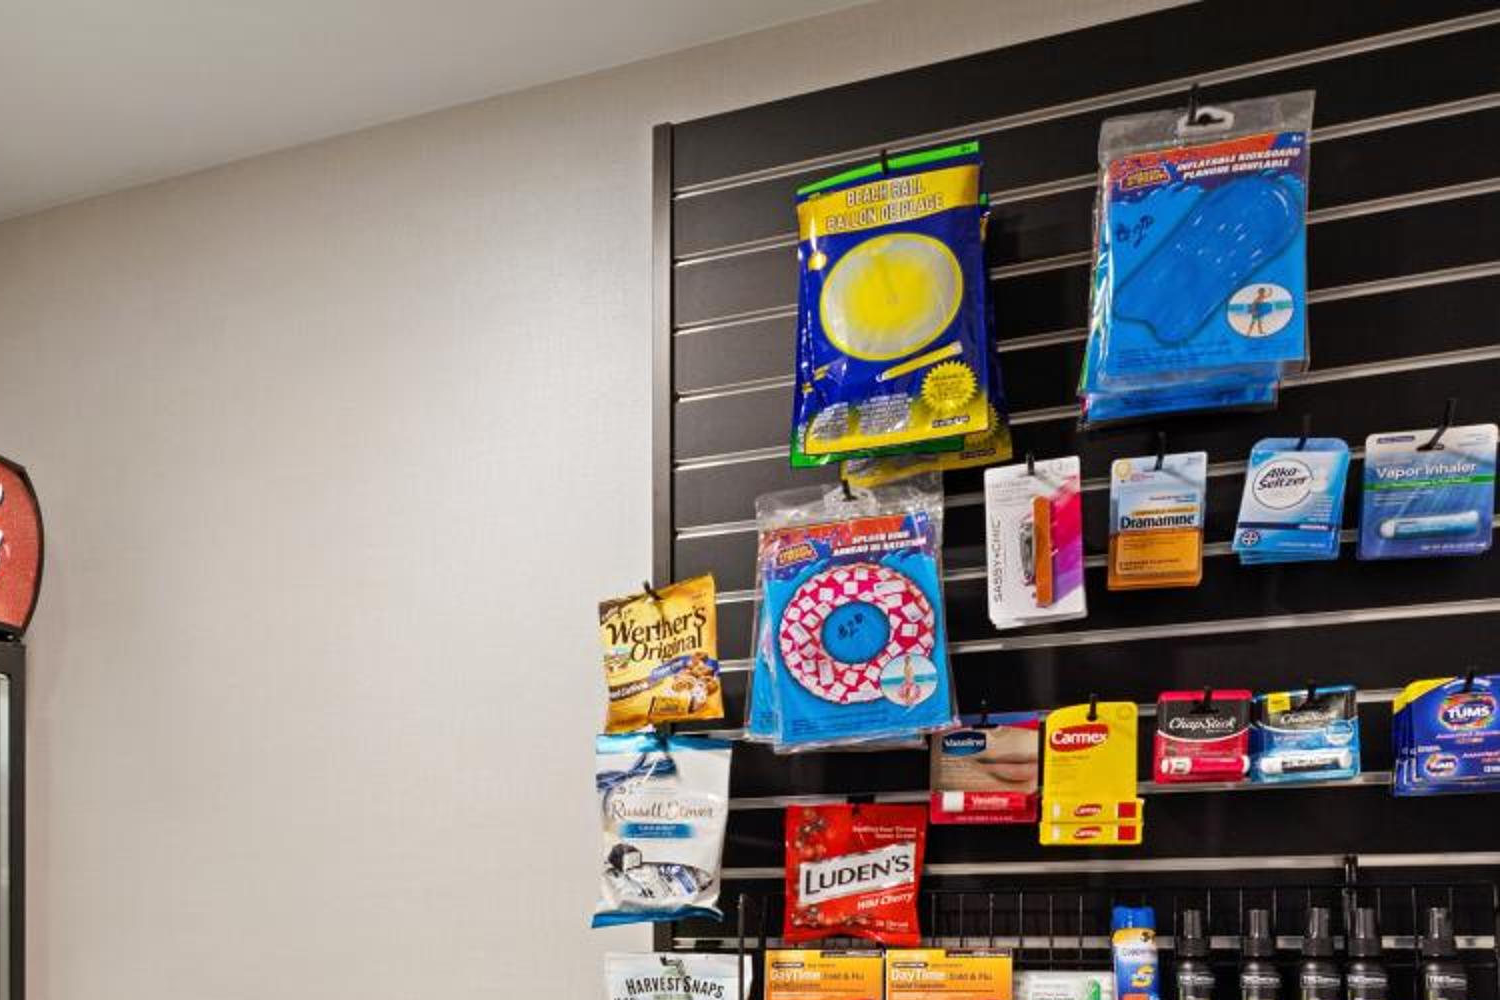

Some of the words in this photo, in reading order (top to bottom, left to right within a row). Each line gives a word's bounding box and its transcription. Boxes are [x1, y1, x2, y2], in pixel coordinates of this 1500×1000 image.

[847, 181, 889, 207] BEACH
[891, 177, 924, 199] BALL
[826, 208, 877, 231] BALLON
[1376, 466, 1423, 480] Vapor
[1425, 462, 1477, 475] Inhaler
[1121, 514, 1195, 529] Dramamine
[607, 606, 707, 645] Werther's
[631, 627, 702, 662] Original
[1169, 717, 1236, 731] ChapStick
[1448, 706, 1490, 719] TUMS
[1051, 731, 1109, 746] Carmex
[806, 855, 910, 895] LUDEN'S
[626, 976, 680, 996] HARVEST
[683, 975, 725, 999] SNAPS
